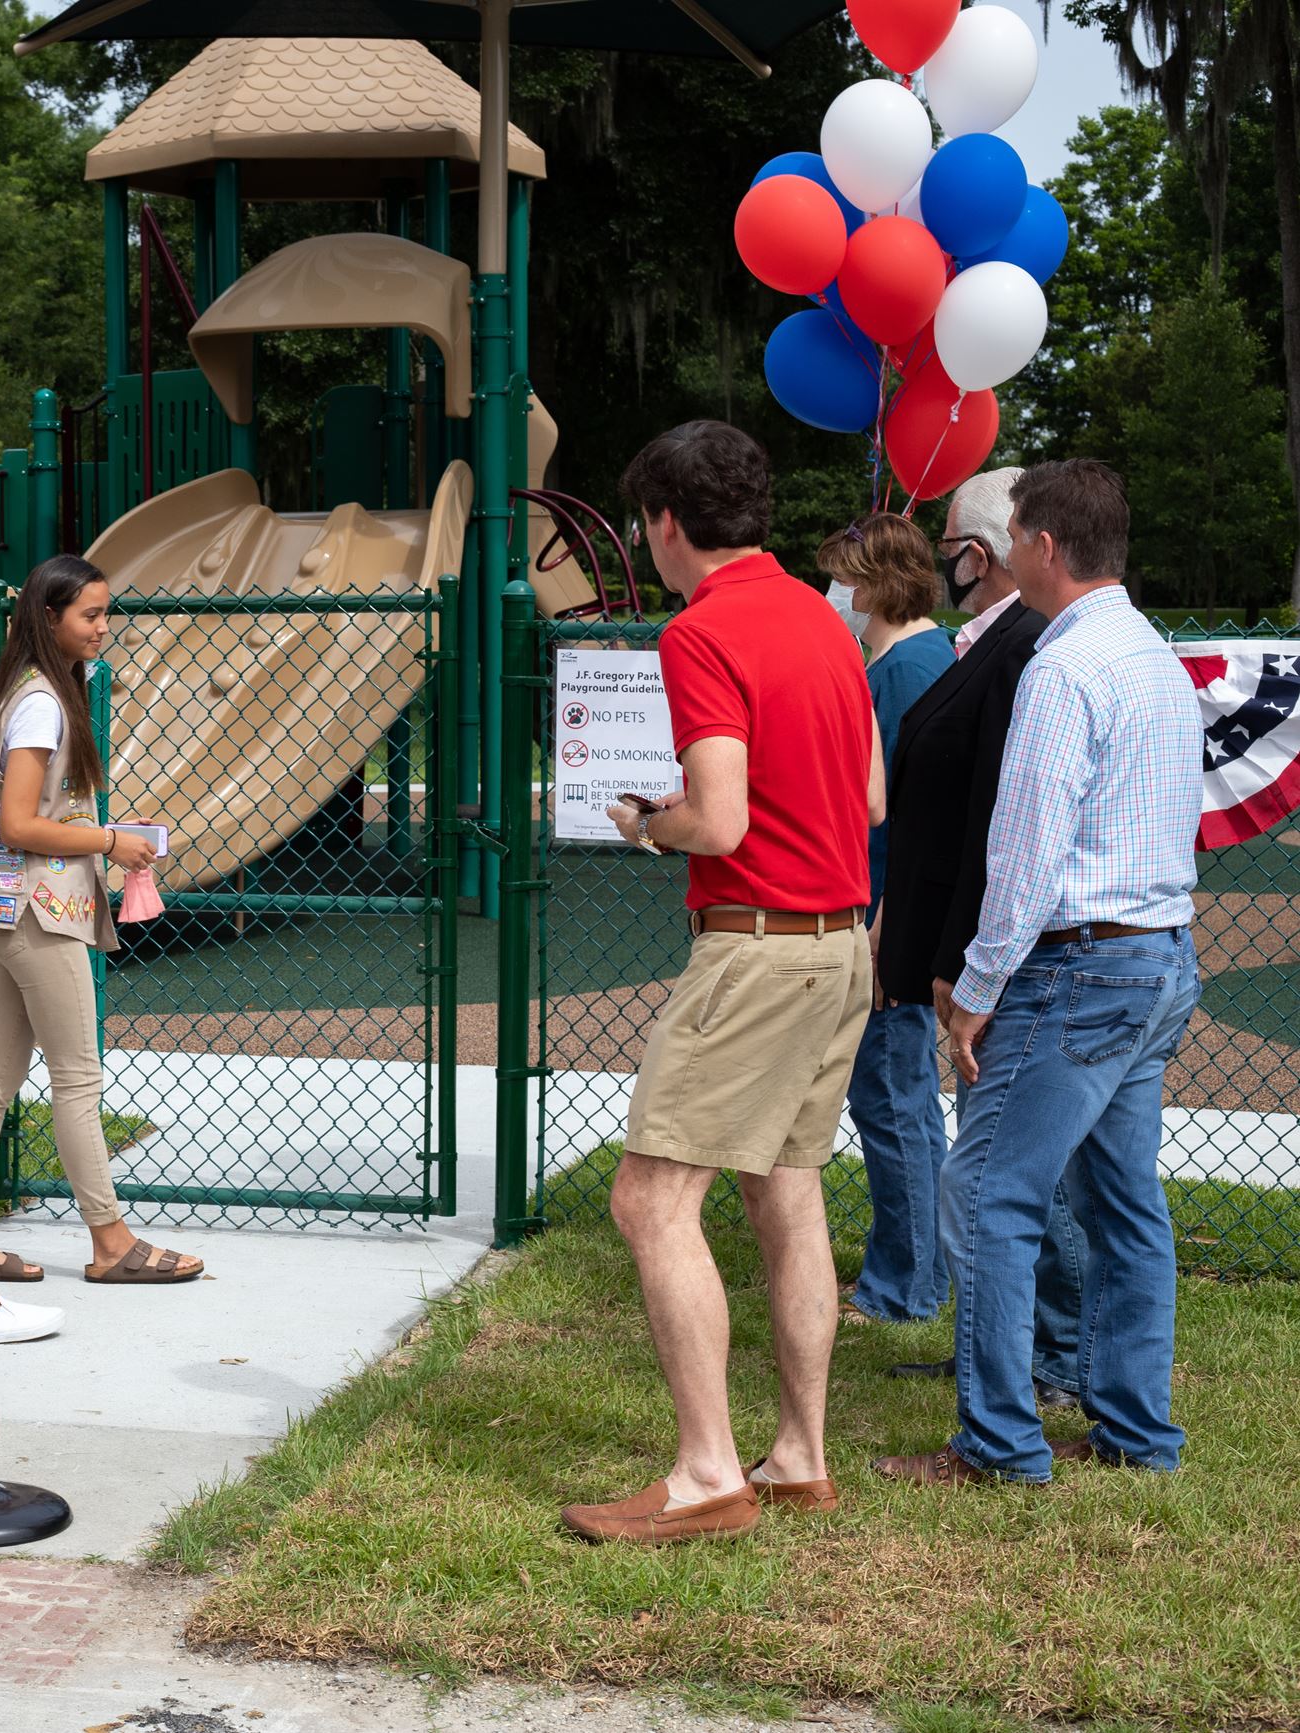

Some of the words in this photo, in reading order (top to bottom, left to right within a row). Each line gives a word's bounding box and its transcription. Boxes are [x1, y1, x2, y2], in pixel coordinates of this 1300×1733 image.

[576, 671, 591, 680] J.F.
[593, 671, 635, 682] Gregory
[637, 672, 660, 681] Park
[561, 683, 619, 694] Playground
[621, 684, 664, 694] Guidelin
[591, 711, 612, 723] NO
[615, 711, 646, 723] PETS
[591, 748, 611, 760] NO
[613, 749, 673, 762] SMOKING
[591, 780, 638, 790] CHILDREN
[641, 781, 668, 791] MUST
[591, 791, 604, 800] BE
[590, 803, 602, 812] AT
